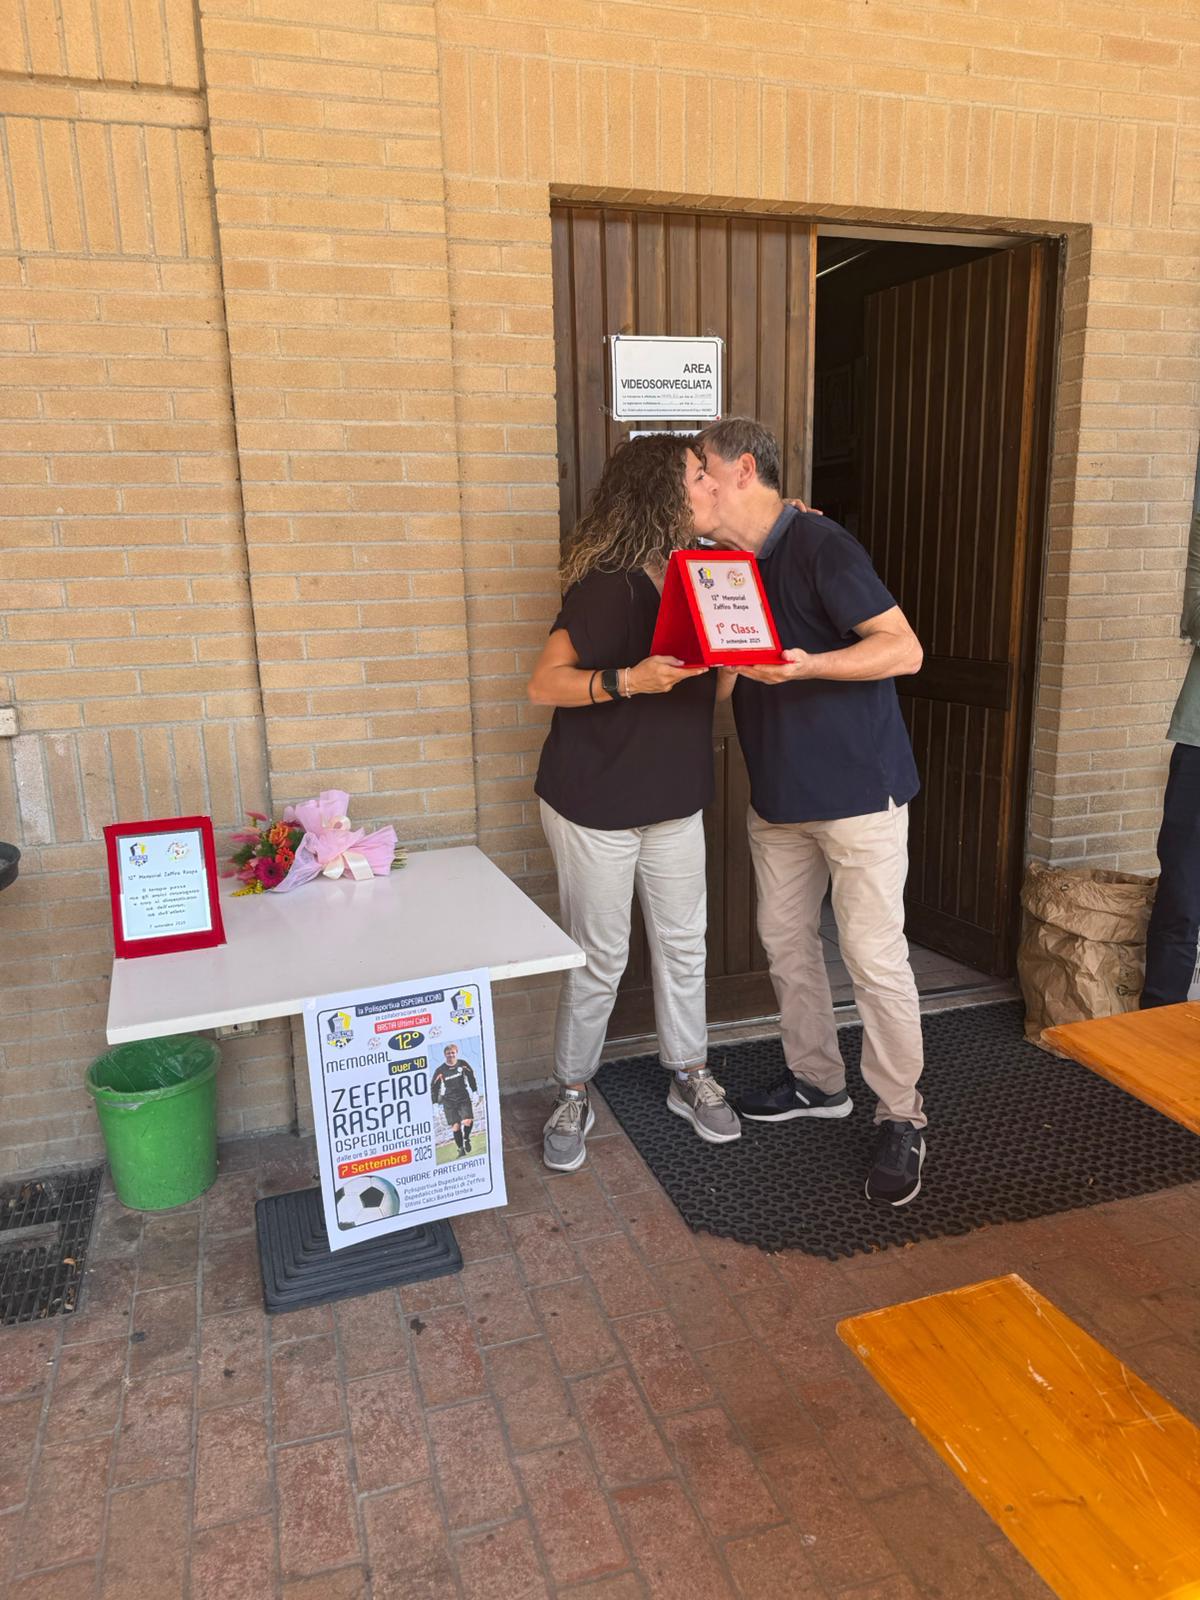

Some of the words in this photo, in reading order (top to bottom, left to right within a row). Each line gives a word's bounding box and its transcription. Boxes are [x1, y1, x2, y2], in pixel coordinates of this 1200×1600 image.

[683, 363, 712, 374] AREA
[620, 378, 713, 390] VIDEOSORVEGLIATA
[731, 623, 759, 634] Class.
[365, 1001, 400, 1014] Polisportiva
[400, 993, 443, 1008] OSPEDALICCHIO
[377, 1020, 396, 1031] BASTIA
[415, 1016, 430, 1026] Calci
[395, 1031, 419, 1050] 12°
[326, 1051, 392, 1073] MEMORIAL
[391, 1062, 411, 1074] over
[413, 1058, 425, 1068] 40
[331, 1072, 428, 1113] ZEFFIRO
[332, 1100, 411, 1138] RASPA
[335, 1121, 431, 1153] OSPEDALICCHIO
[337, 1153, 351, 1162] dalle
[352, 1151, 363, 1160] ore
[382, 1135, 432, 1152] DOMENICA
[341, 1167, 349, 1177] 7
[351, 1154, 409, 1172] Settembre
[414, 1144, 433, 1162] 2025
[396, 1170, 431, 1186] SQUADRE
[432, 1157, 486, 1177] PARTECIPANTI
[404, 1182, 438, 1195] Polisportiva
[438, 1173, 476, 1187] Ospedalicchio
[404, 1188, 444, 1202] Ospedalicchio
[444, 1184, 460, 1193] Amici
[466, 1177, 486, 1186] Zeffiro
[422, 1196, 436, 1204] Calci
[437, 1192, 455, 1201] Bastia
